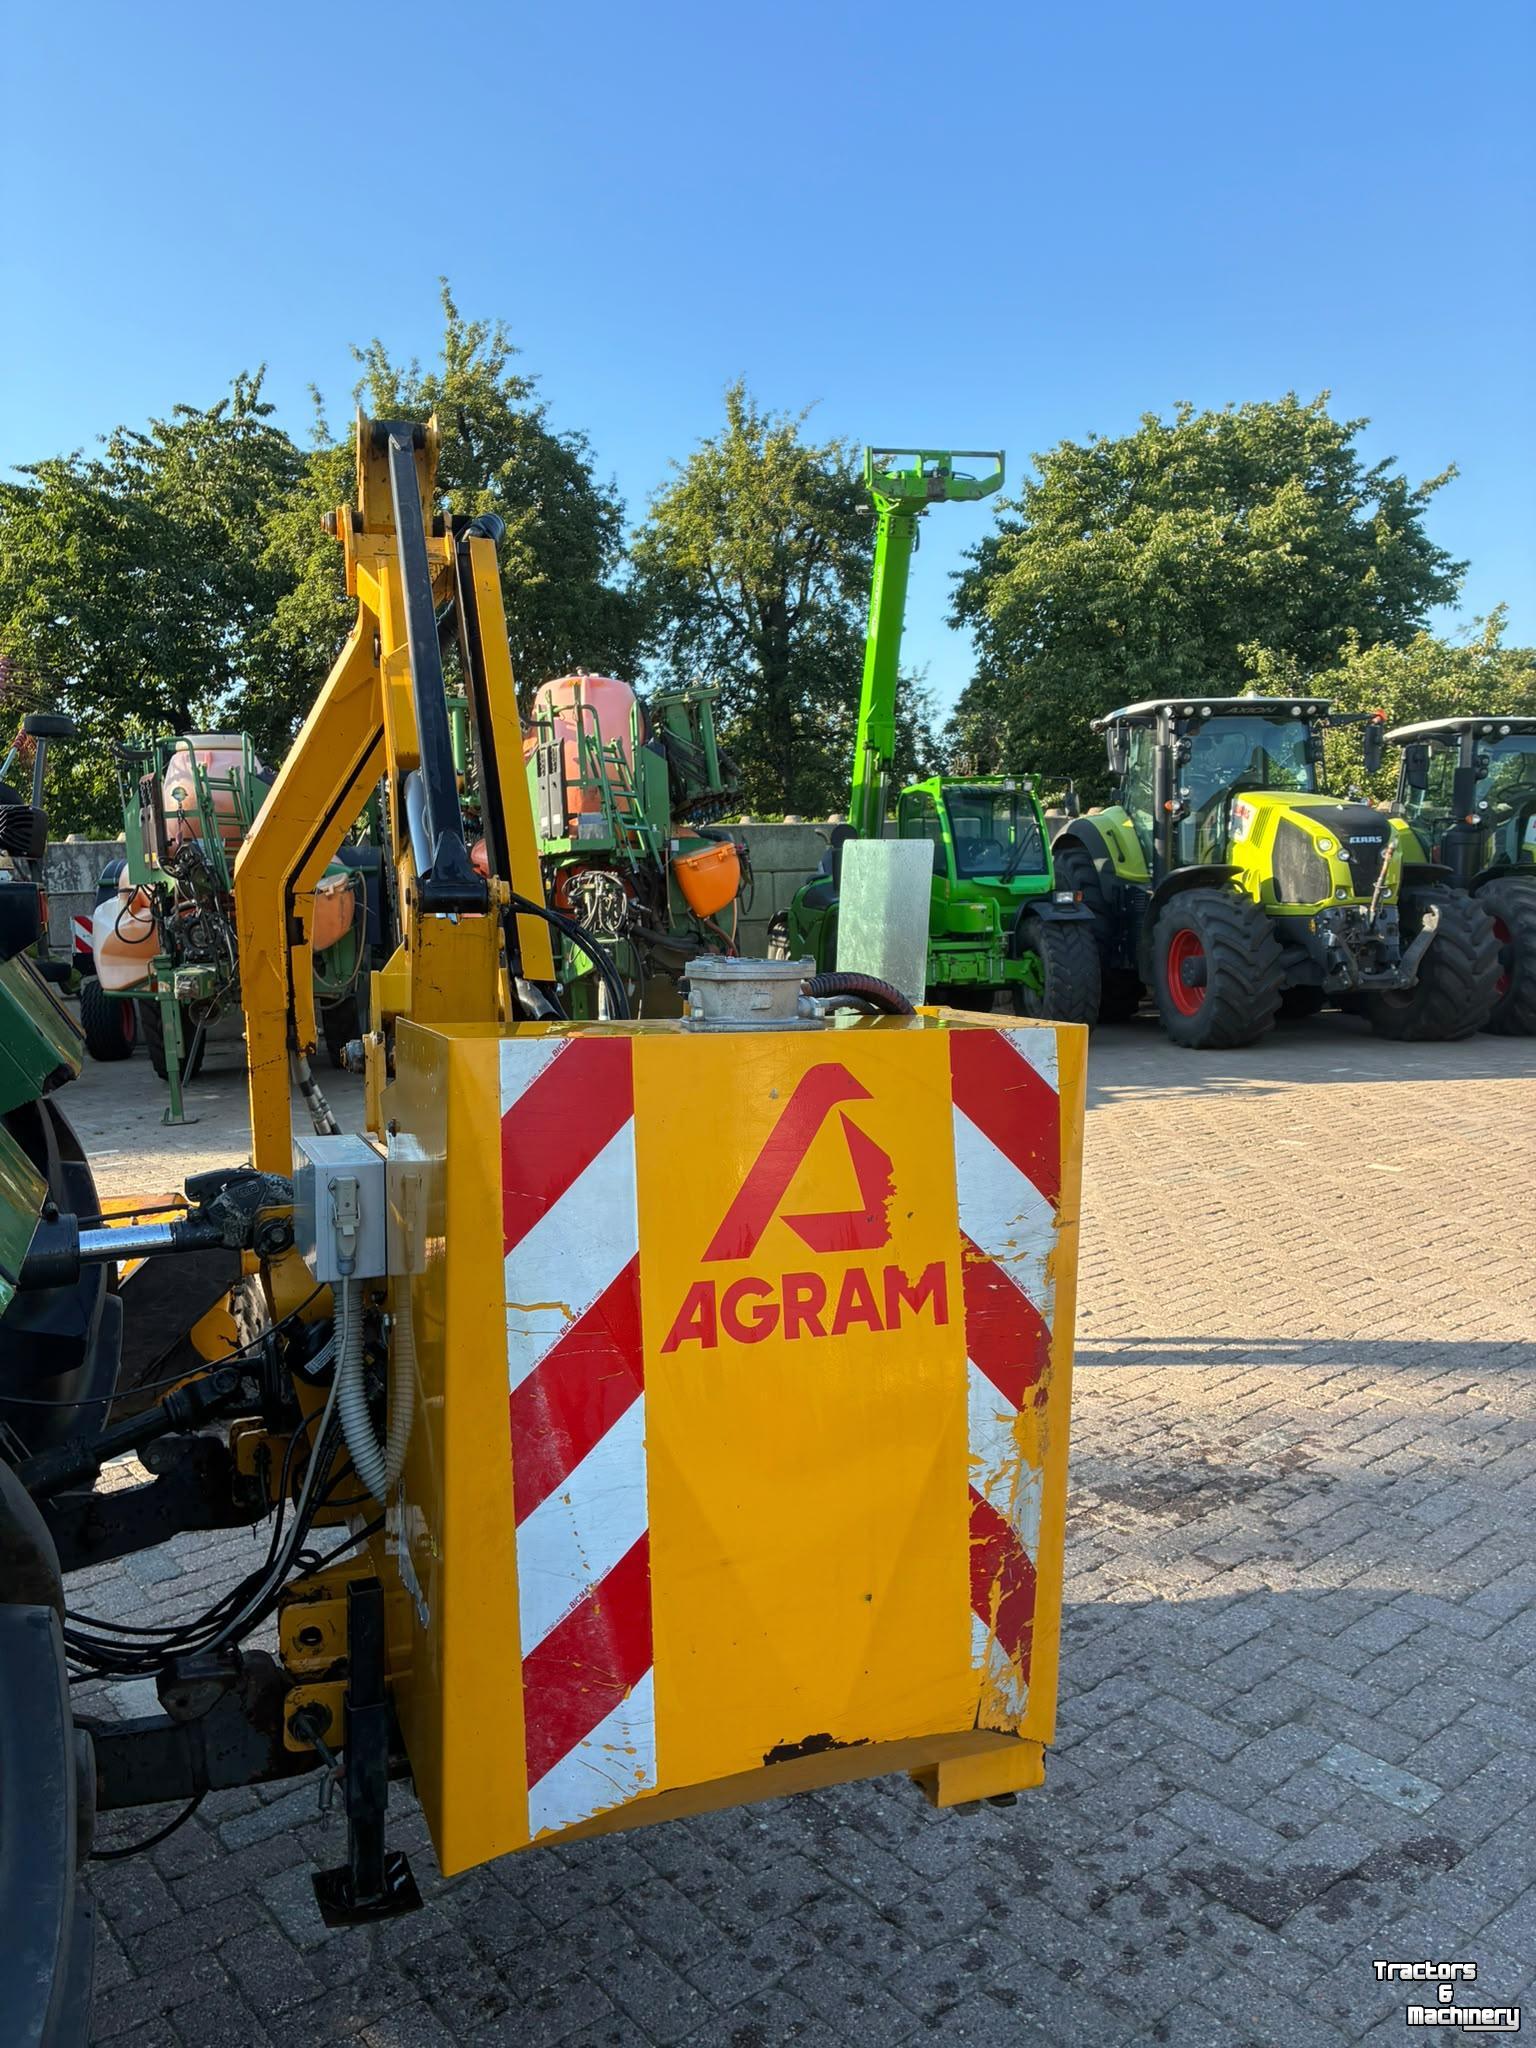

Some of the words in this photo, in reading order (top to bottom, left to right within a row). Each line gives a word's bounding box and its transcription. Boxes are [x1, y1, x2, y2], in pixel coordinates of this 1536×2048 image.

[1349, 836, 1382, 844] CLAAS
[551, 1037, 573, 1057] BICM
[659, 1261, 949, 1354] AGRAM
